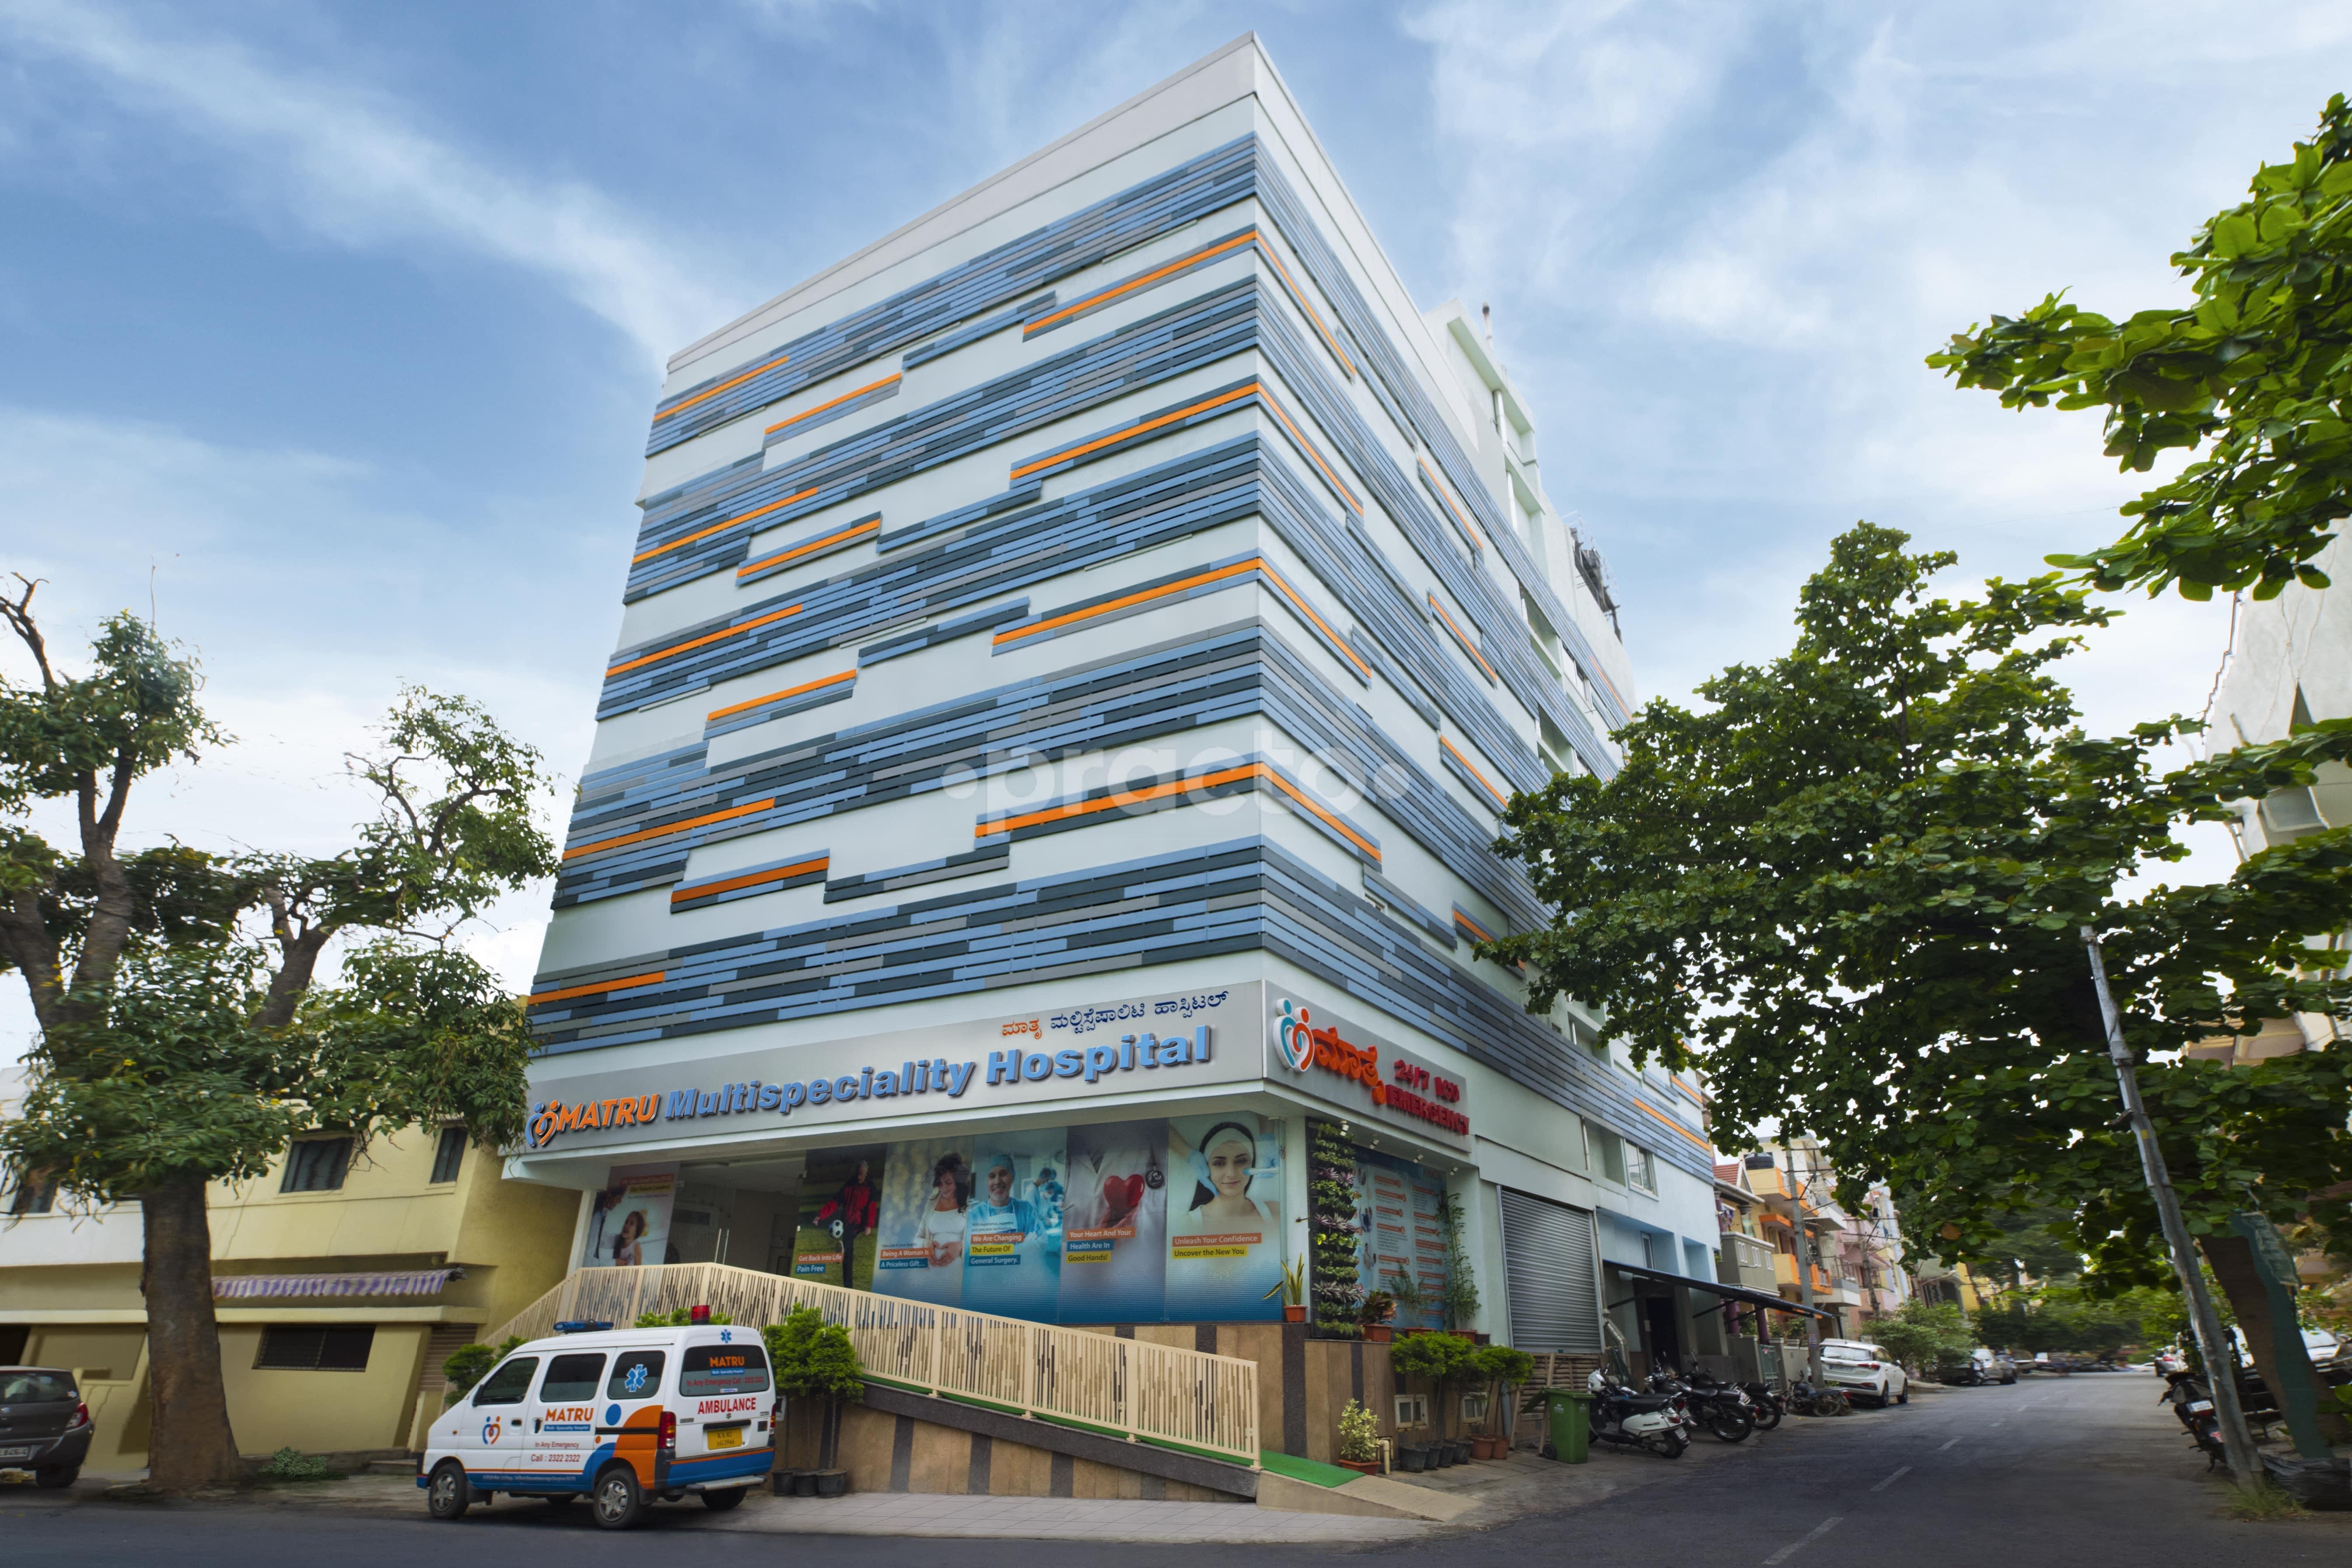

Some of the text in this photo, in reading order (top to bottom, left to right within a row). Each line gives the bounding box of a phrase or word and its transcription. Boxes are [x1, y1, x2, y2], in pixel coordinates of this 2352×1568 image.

[1002, 1018, 1043, 1040] ಮಾತೃ
[556, 1024, 1211, 1133] MATRU Multispeciality Hospital
[1394, 1059, 1460, 1103] 24/7 ICU
[1386, 1084, 1470, 1135] EMERGENCY
[994, 1234, 1022, 1242] Changing
[1219, 1234, 1258, 1243] Confidence
[1068, 1253, 1108, 1262] Good Hands!
[1174, 1249, 1201, 1257] Uncover
[709, 1356, 745, 1368] MATRU
[693, 1379, 703, 1387] Any
[705, 1377, 732, 1386] Emergency
[697, 1397, 756, 1414] AMBULANCE
[545, 1407, 594, 1421] MATRU
